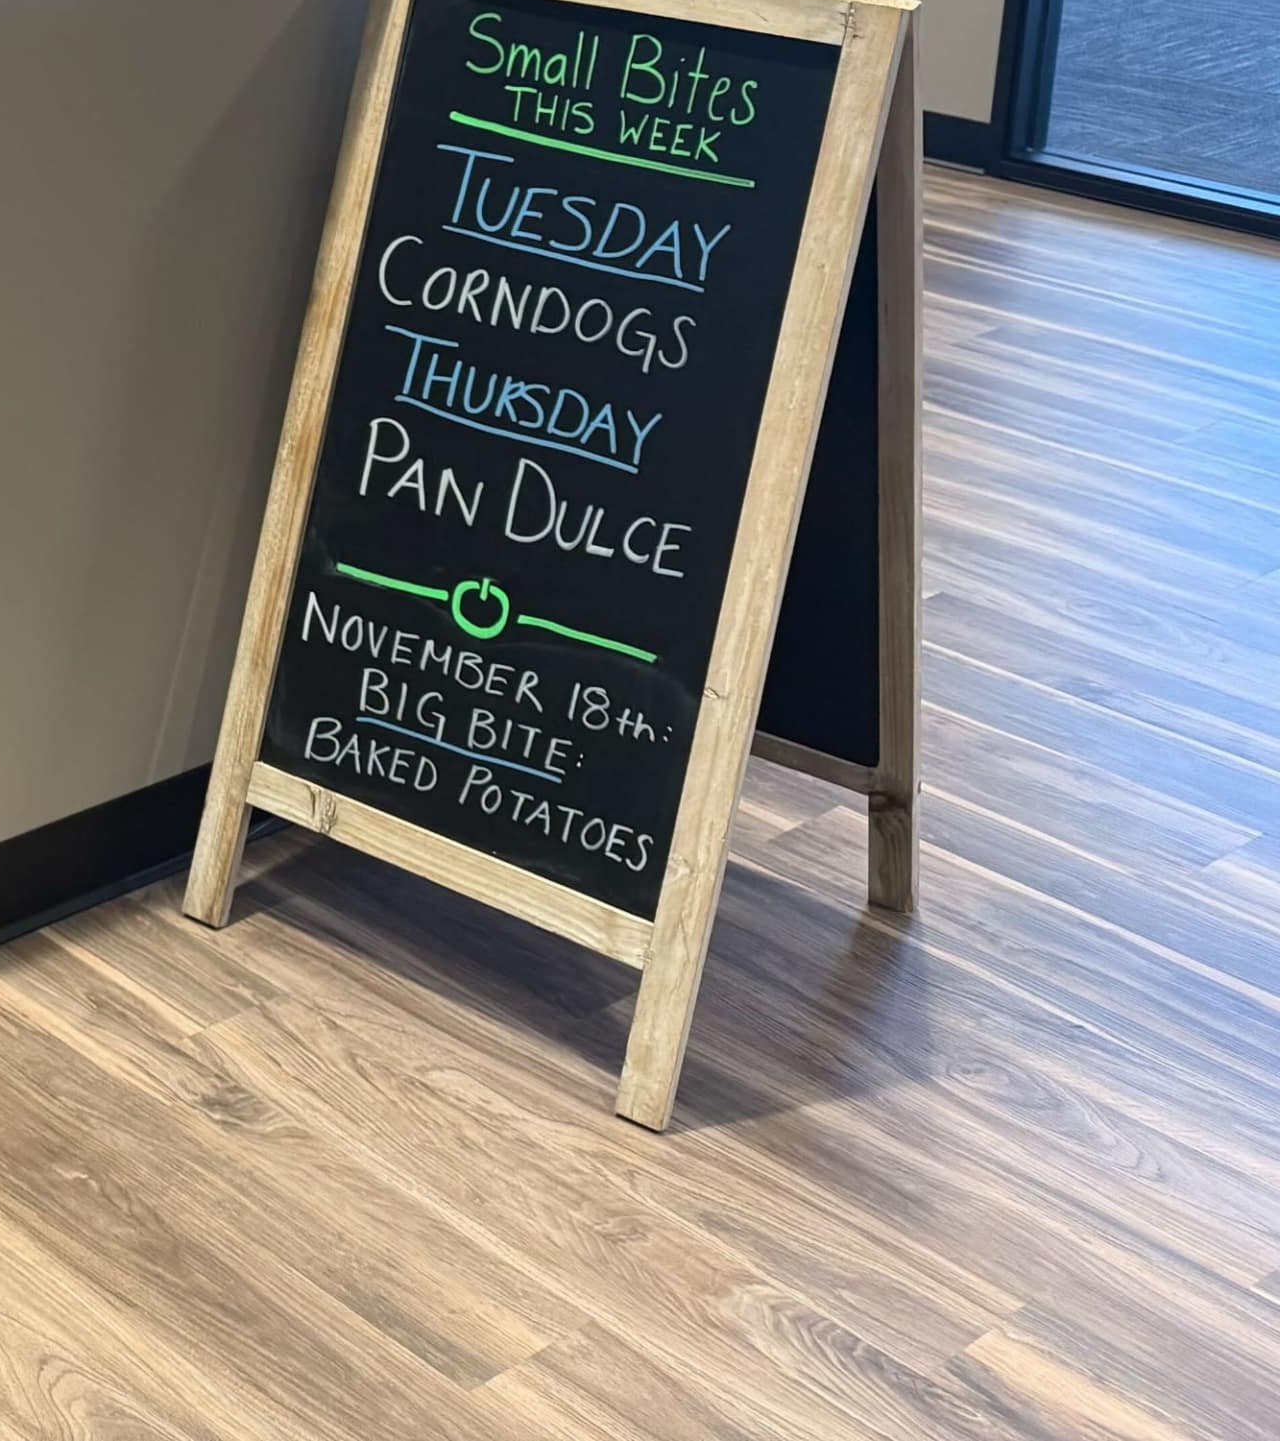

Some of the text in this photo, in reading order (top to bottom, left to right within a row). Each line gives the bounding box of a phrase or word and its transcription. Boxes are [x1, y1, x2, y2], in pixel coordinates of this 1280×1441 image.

[465, 12, 758, 126] Small Bites
[504, 85, 722, 163] THIS WEEK
[436, 143, 732, 282] TUESDAY
[378, 234, 697, 374] CORNDOGS
[384, 324, 663, 466] THURSDAY
[359, 417, 693, 578] PAN DULCE
[301, 591, 674, 744] NOVEMBER 18th:
[359, 667, 585, 776] BIG BITE:
[304, 716, 655, 872] BAKED POTATOES
